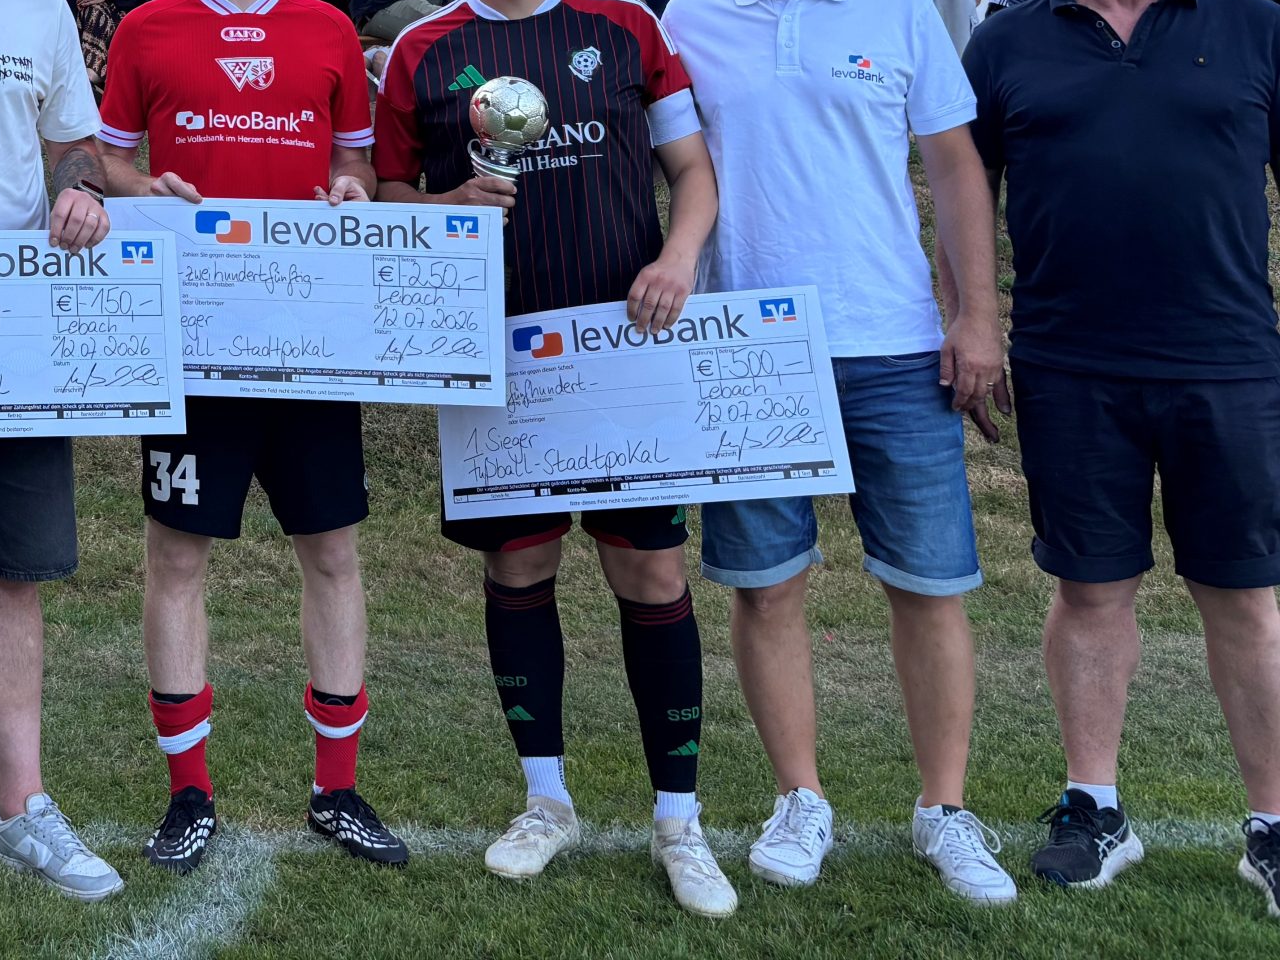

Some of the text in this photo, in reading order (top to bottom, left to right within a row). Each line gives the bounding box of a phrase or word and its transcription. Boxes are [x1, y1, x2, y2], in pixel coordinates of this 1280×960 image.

[223, 28, 263, 38] JAKO
[11, 56, 33, 70] PAIN
[13, 71, 34, 85] GAIN
[831, 66, 885, 84] levoBank
[208, 108, 301, 133] levoBank
[175, 133, 316, 149] Die Volksbank im Herzen des Saarlandes
[467, 121, 606, 156] OGANO
[536, 154, 578, 171] Haus
[262, 211, 433, 250] levoBank
[378, 265, 395, 282] €
[56, 294, 72, 312] €
[378, 283, 445, 306] Lebach
[57, 316, 118, 335] Lebach
[181, 314, 214, 341] eger
[373, 306, 479, 331] 12.07.2026
[50, 335, 151, 360] 12.07.2026
[696, 359, 714, 377] €
[699, 378, 767, 400] Lebach
[695, 395, 810, 428] 12.07.2026
[485, 426, 539, 465] Sieger
[149, 449, 200, 506] 34
[494, 675, 528, 688] SSD
[666, 705, 700, 722] SSD
